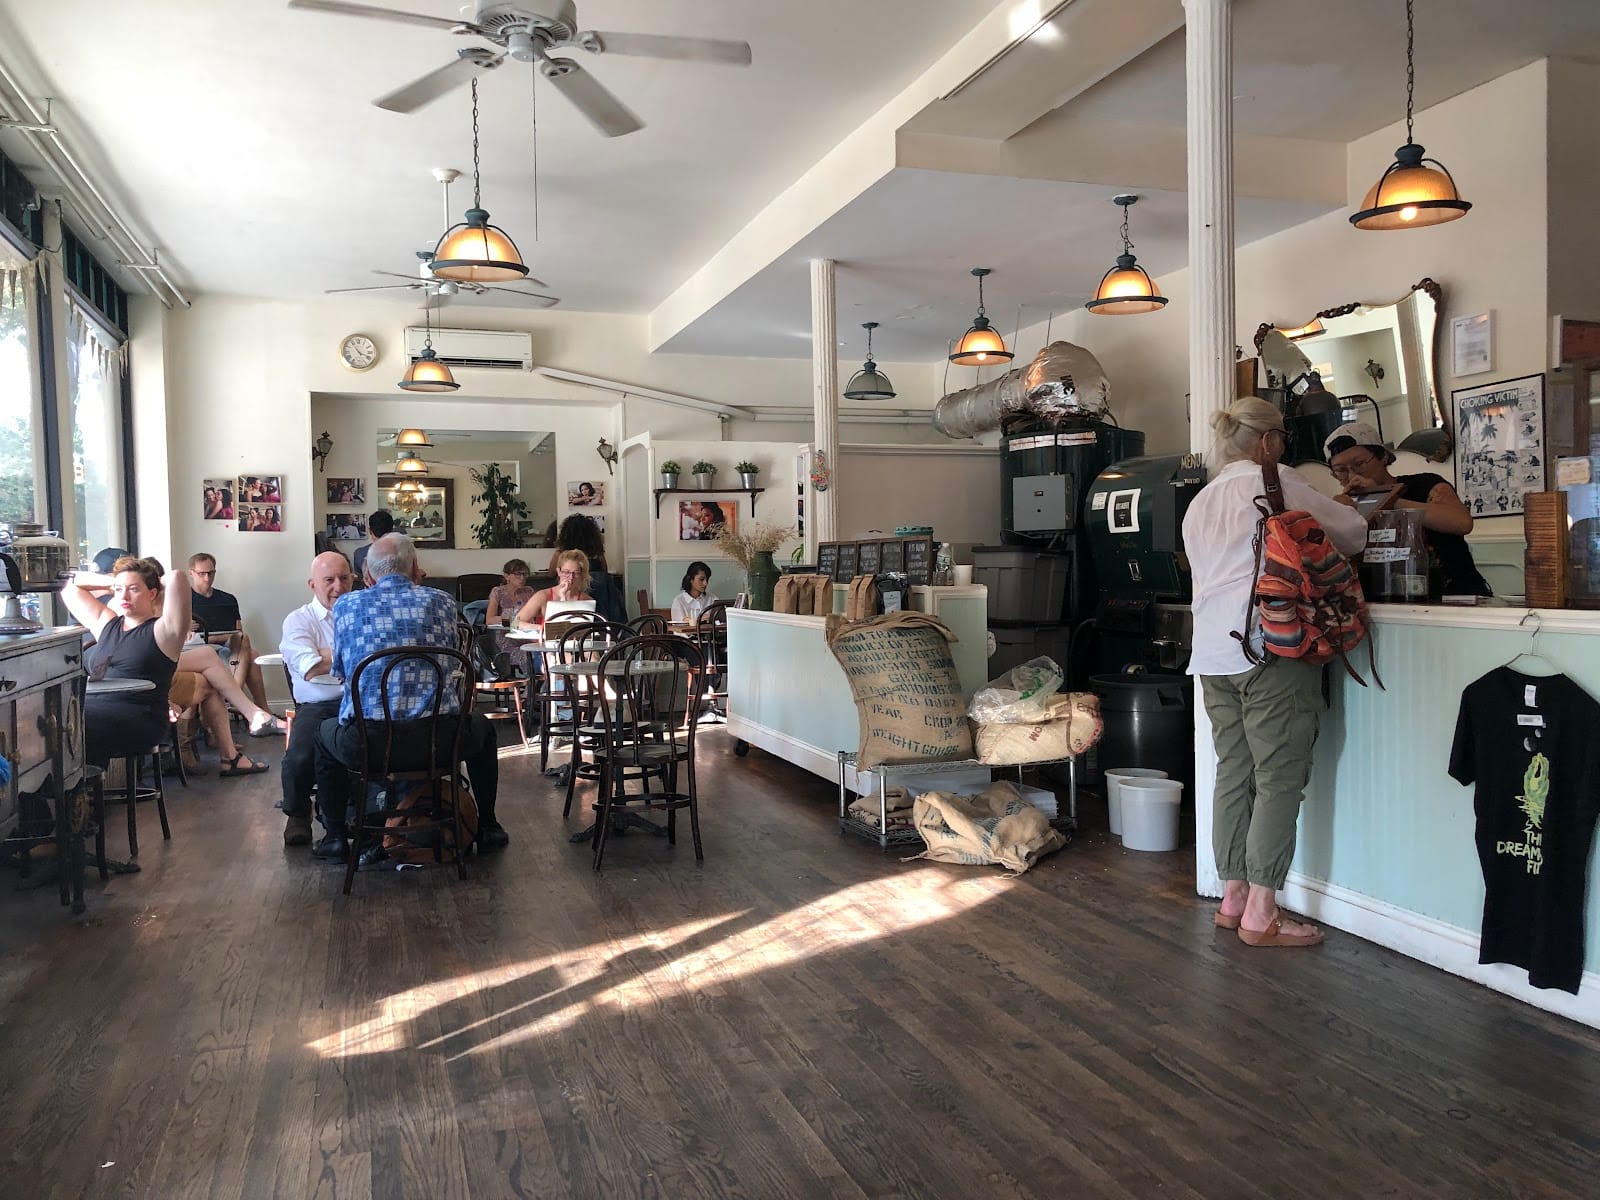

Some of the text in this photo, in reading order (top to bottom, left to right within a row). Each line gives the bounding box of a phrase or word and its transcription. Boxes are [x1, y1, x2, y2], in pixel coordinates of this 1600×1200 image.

[1460, 390, 1518, 409] CHOKING VICTIM
[1181, 453, 1203, 469] MENU
[871, 703, 903, 720] YEAR
[873, 729, 921, 753] WEIGHT
[1496, 841, 1542, 861] DREAM
